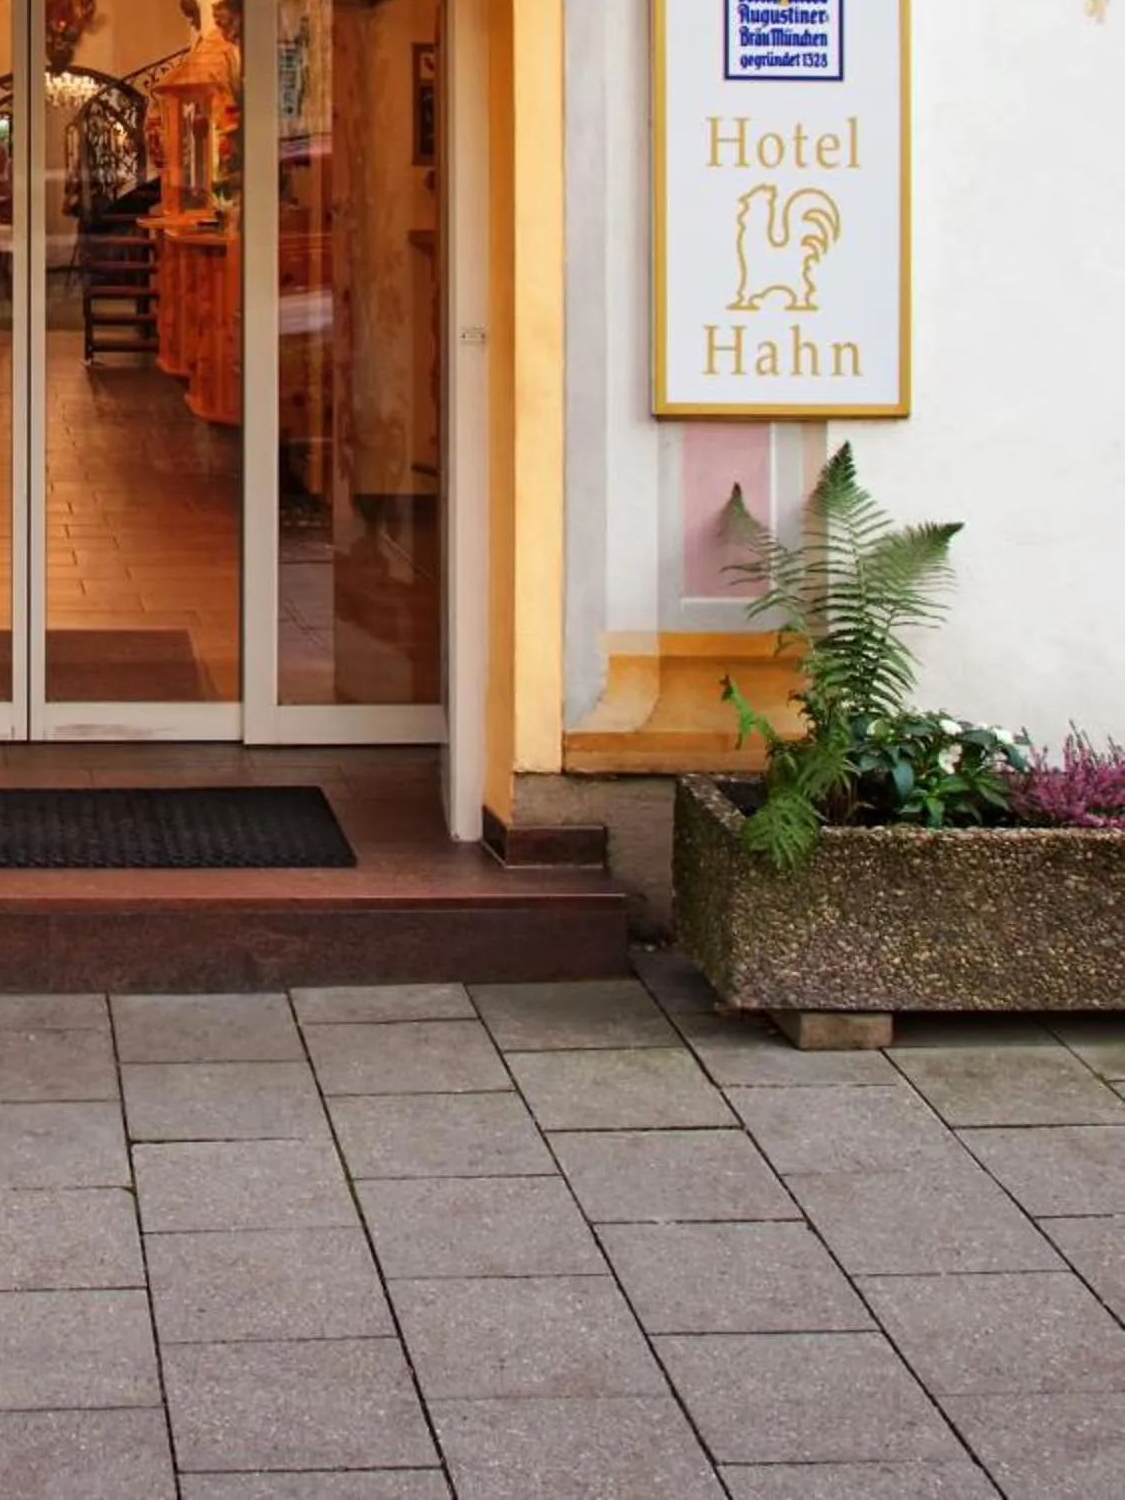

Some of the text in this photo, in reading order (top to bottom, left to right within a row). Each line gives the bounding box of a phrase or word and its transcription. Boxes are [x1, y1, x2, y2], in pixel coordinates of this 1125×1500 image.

[770, 26, 828, 47] München
[739, 51, 828, 70] gegründet 1328
[705, 116, 862, 169] Hotel
[703, 325, 863, 377] Hahn
